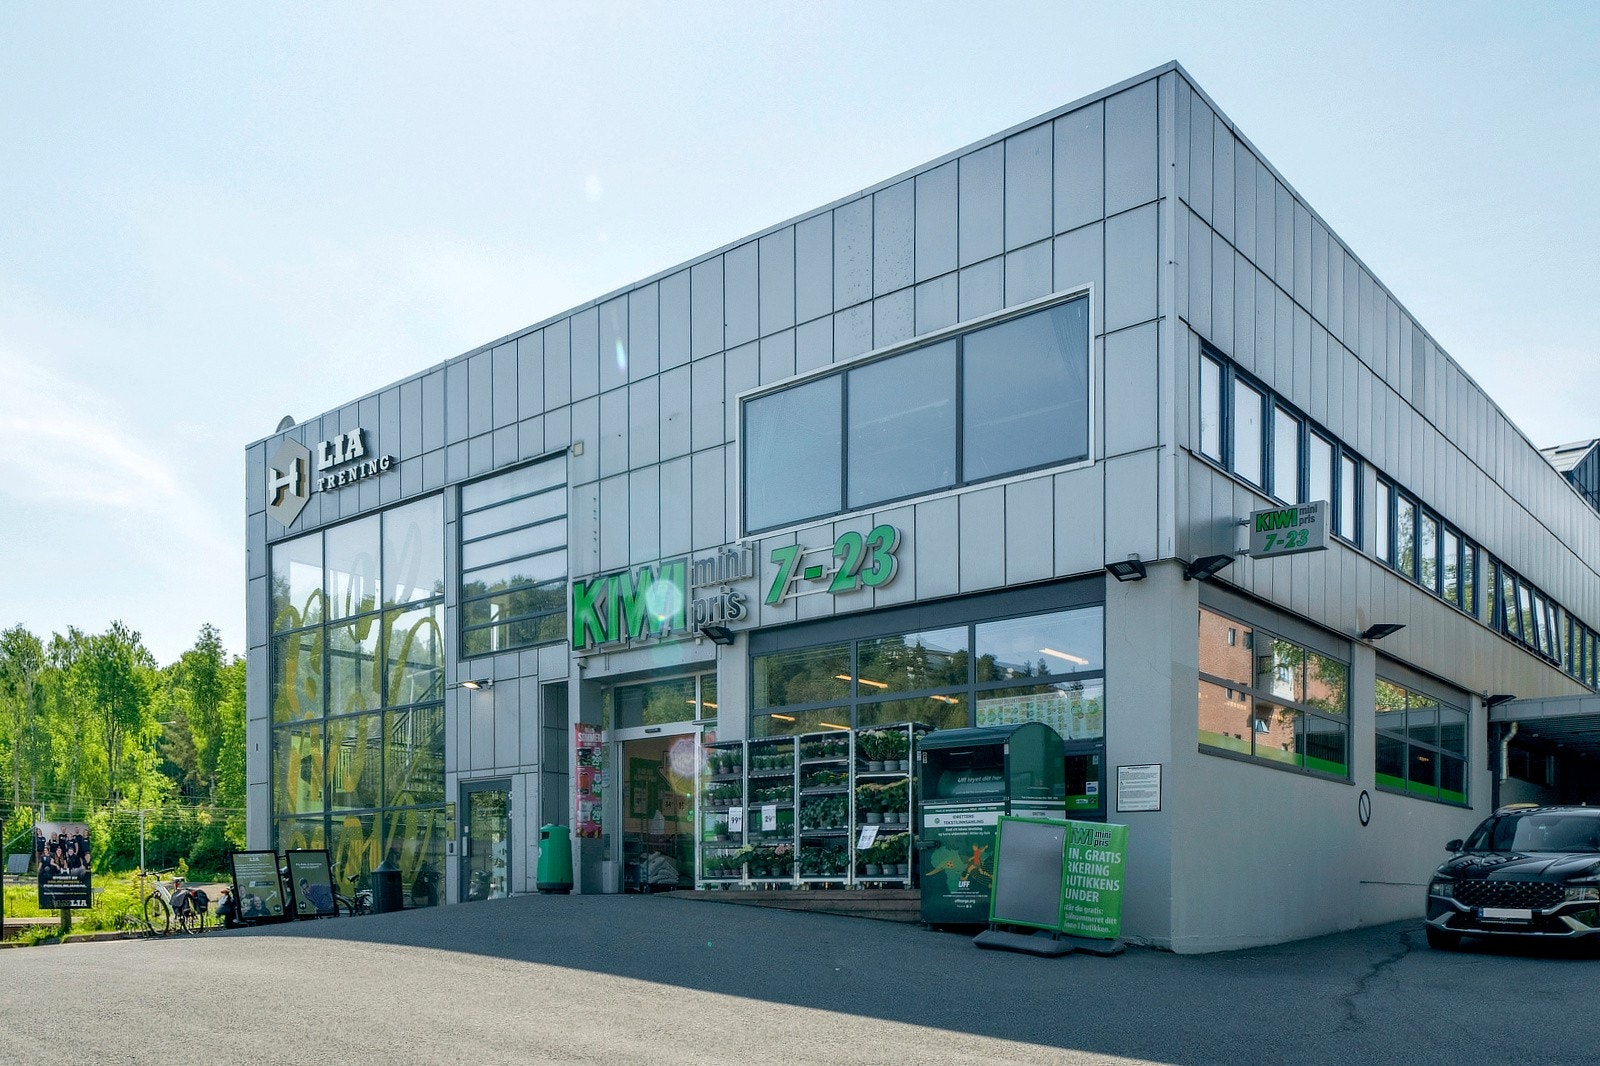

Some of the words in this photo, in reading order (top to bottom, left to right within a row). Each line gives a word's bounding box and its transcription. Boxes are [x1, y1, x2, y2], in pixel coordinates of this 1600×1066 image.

[317, 427, 366, 471] LIA
[317, 455, 392, 492] TRENING
[1256, 507, 1298, 532] KIWI
[1299, 503, 1318, 515] mini
[1299, 514, 1316, 526] pris
[1263, 528, 1310, 552] 7-23
[692, 546, 753, 588] mini
[572, 557, 690, 651] KIWI
[692, 585, 748, 634] pris
[1085, 849, 1121, 864] GRATIS
[1065, 887, 1100, 903] UNDER
